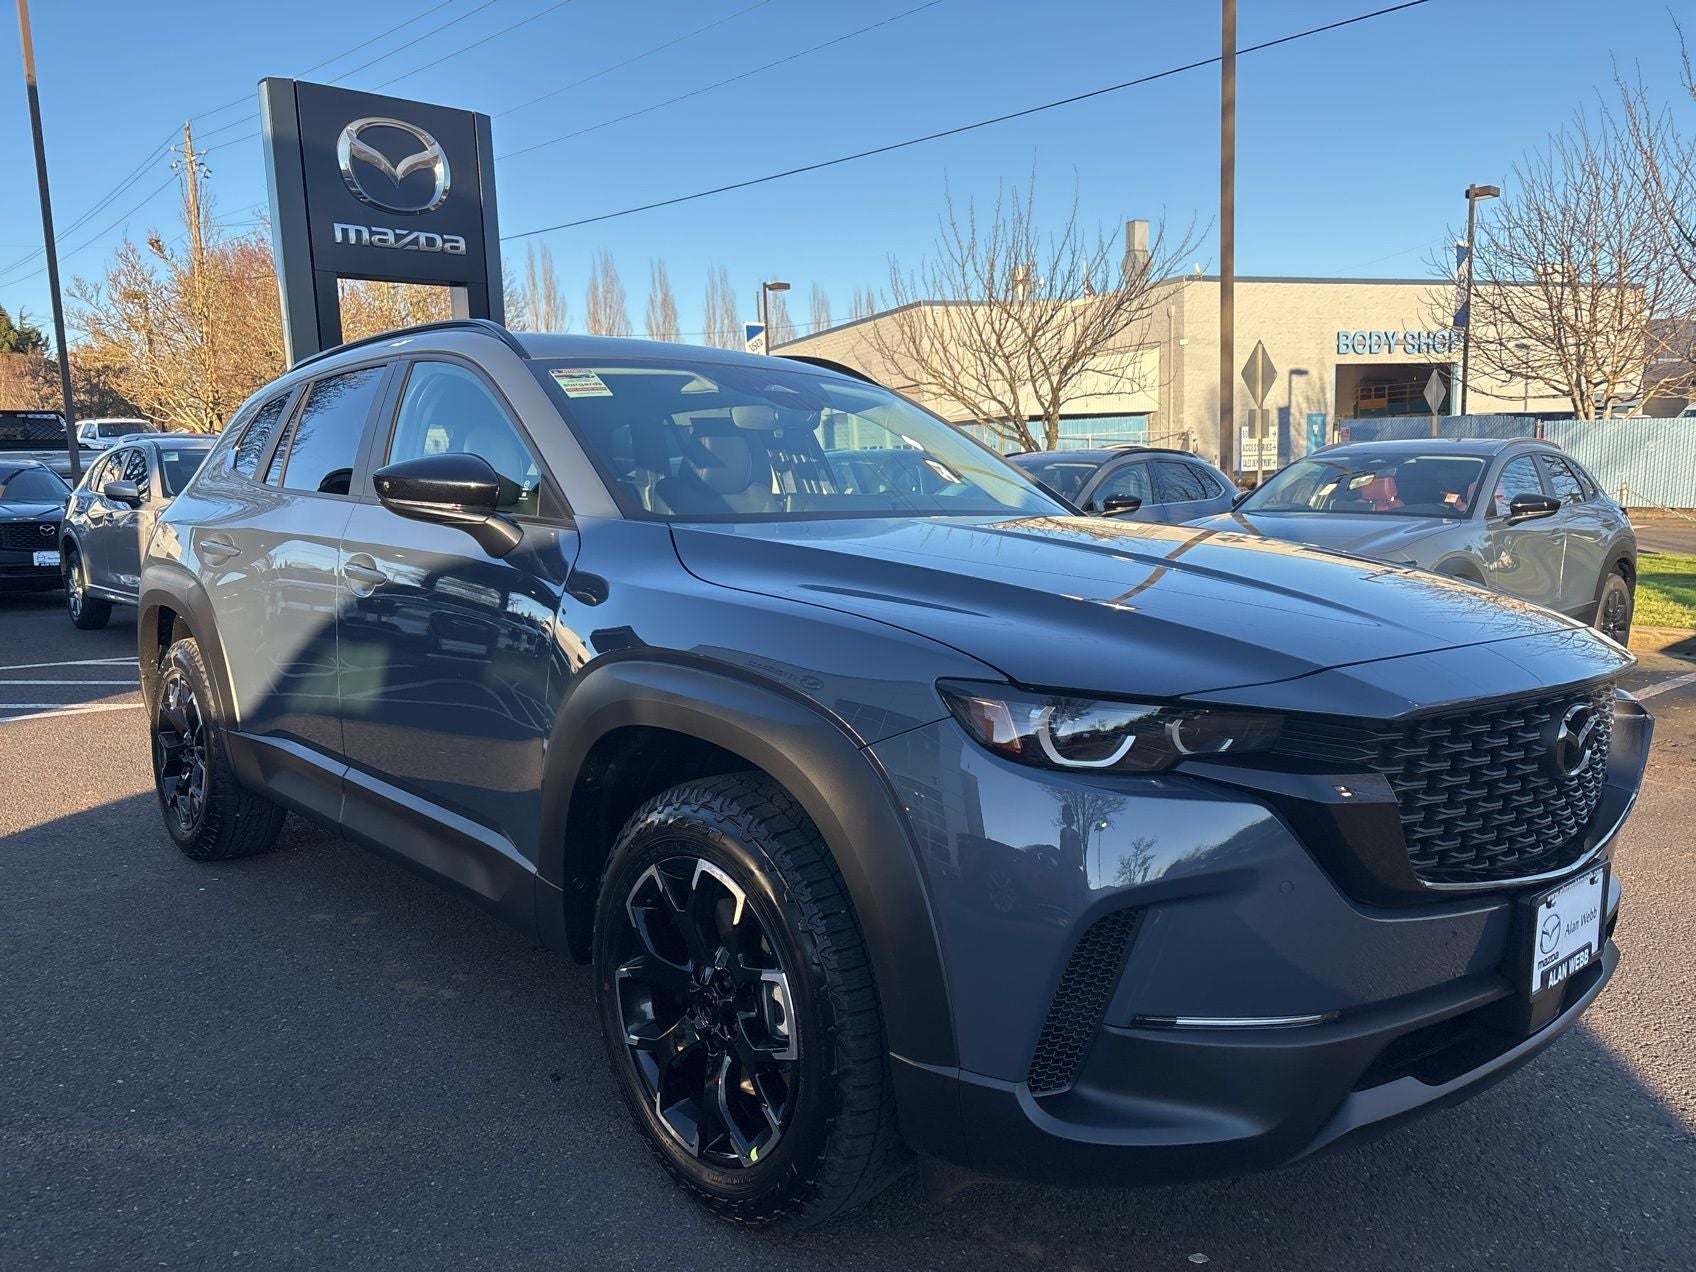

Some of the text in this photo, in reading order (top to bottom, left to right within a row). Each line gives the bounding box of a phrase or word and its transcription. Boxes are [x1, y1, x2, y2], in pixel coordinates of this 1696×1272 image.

[333, 222, 467, 256] mazda
[1337, 330, 1460, 355] BODY SHOP
[1565, 907, 1597, 937] Alan Webb
[1547, 948, 1589, 989] ALAN WEBB
